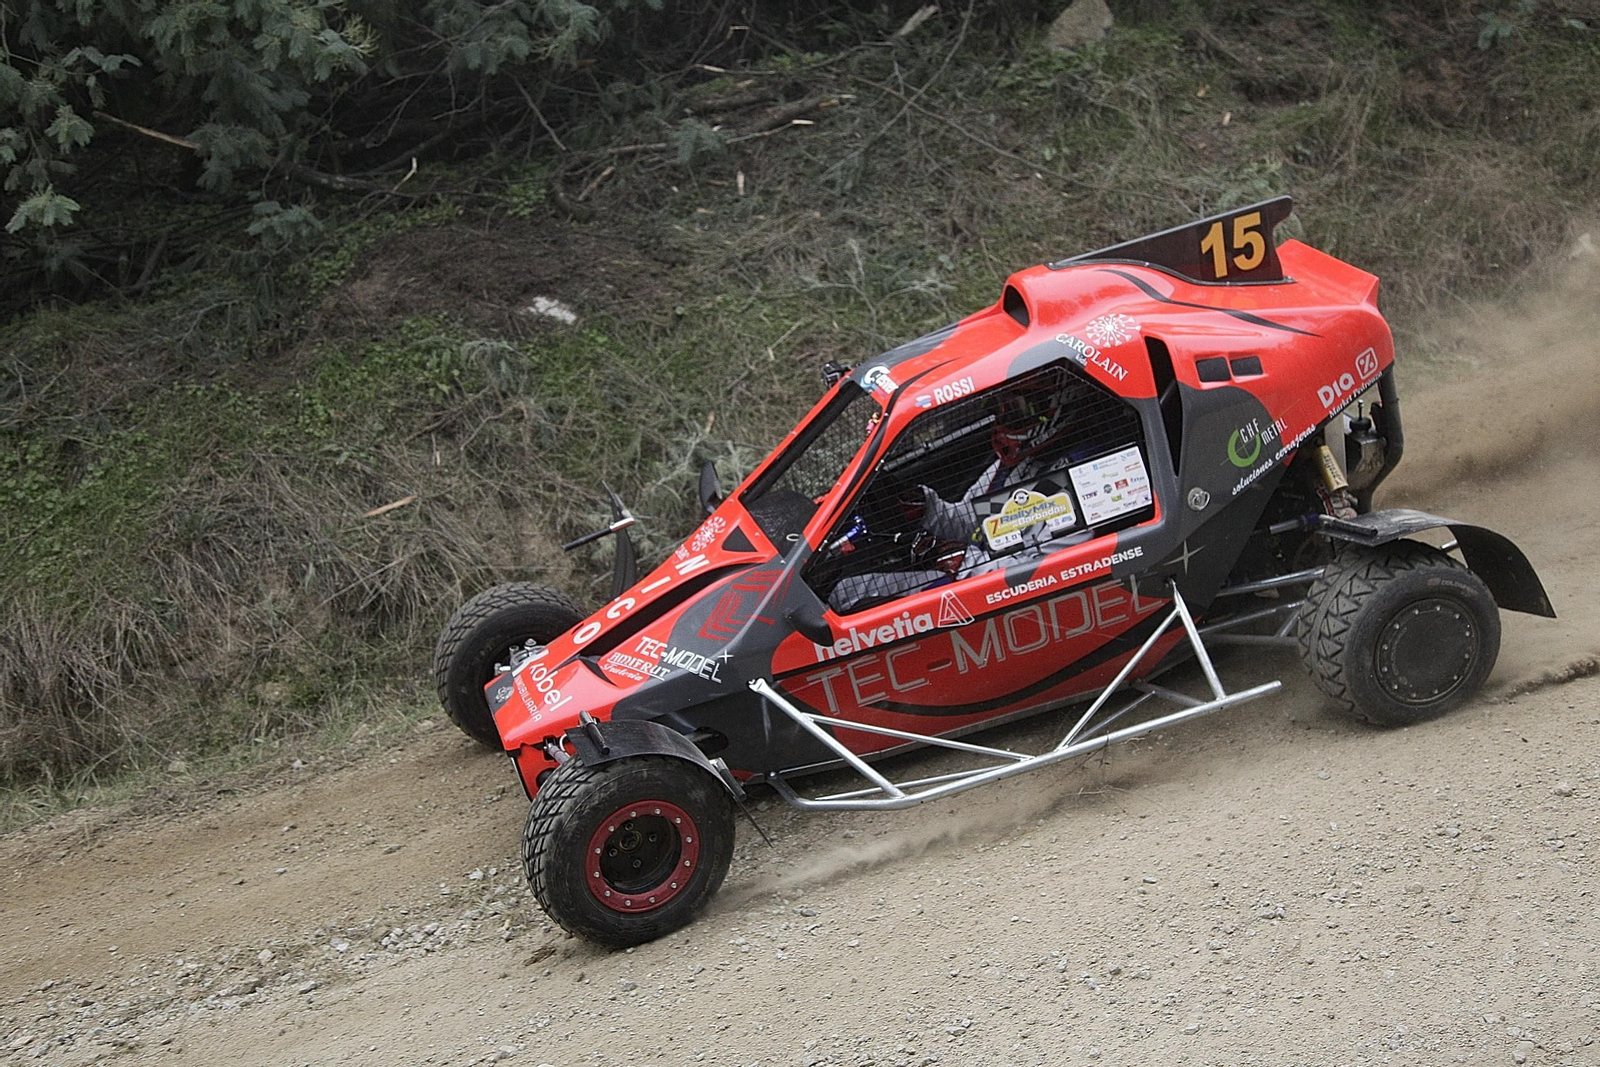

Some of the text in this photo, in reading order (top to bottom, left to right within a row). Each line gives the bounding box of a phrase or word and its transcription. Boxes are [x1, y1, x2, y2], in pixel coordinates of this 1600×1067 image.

[1201, 212, 1265, 278] 15
[1055, 333, 1129, 382] CAROLAIN
[933, 376, 976, 406] ROSSI
[1261, 417, 1288, 446] METAL
[1231, 458, 1273, 496] soluciones
[989, 519, 999, 535] 7
[986, 546, 1144, 604] ESCUDERIA ESTRADENSE
[635, 635, 722, 684] TEC-MODEL
[806, 574, 1164, 716] TEC-MODEL
[814, 610, 935, 662] helvetia
[608, 652, 671, 679] AMIFRUT
